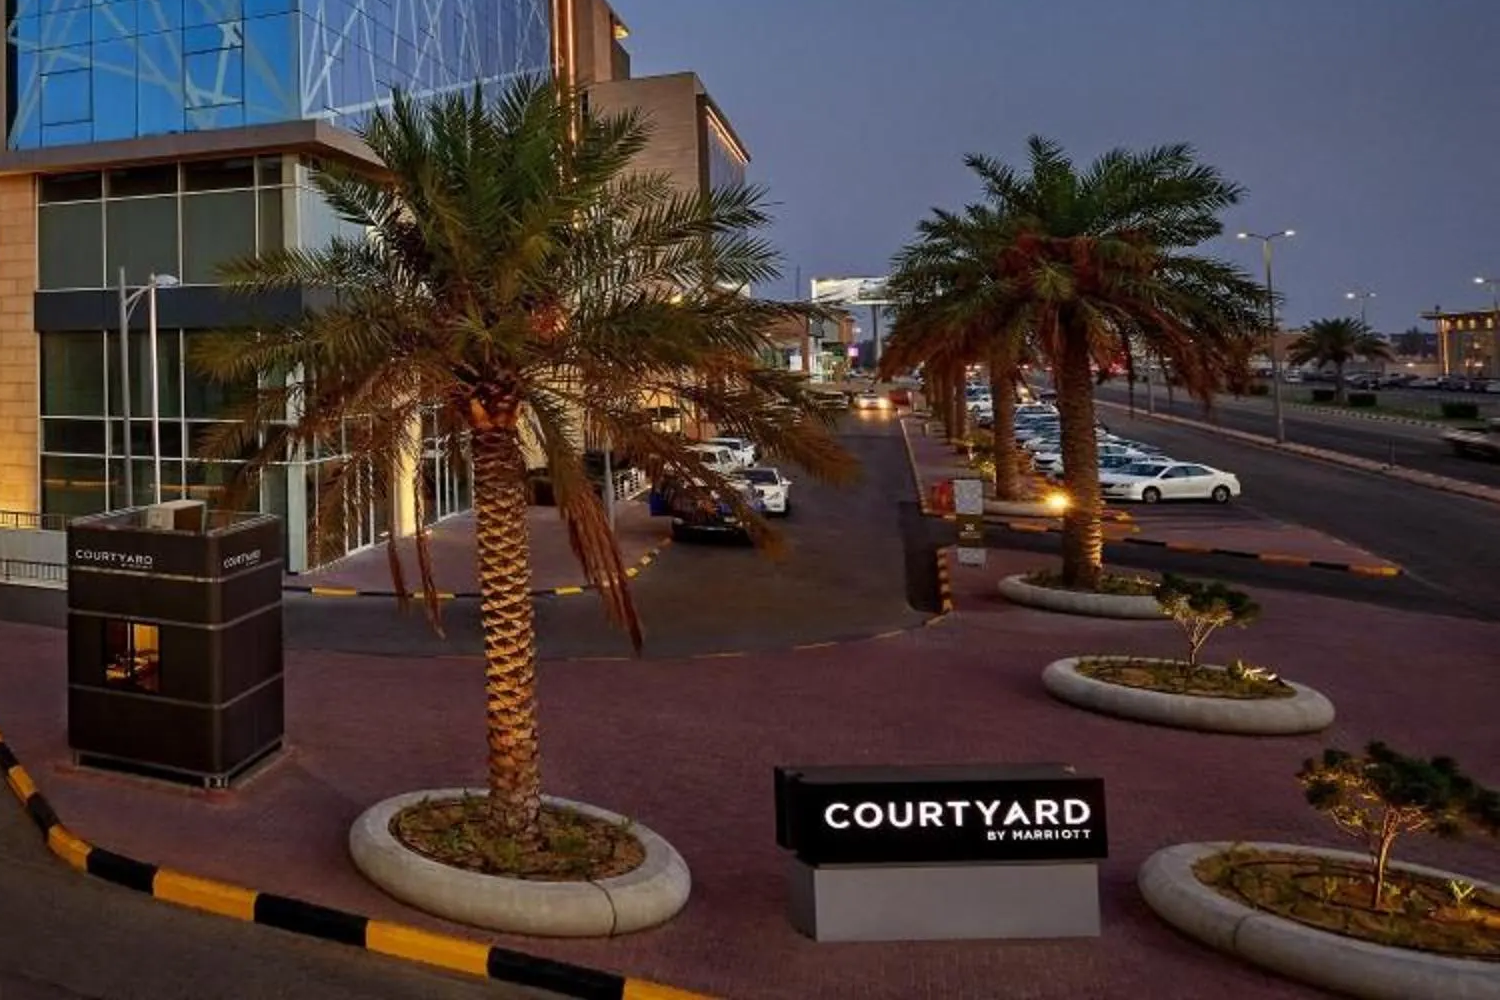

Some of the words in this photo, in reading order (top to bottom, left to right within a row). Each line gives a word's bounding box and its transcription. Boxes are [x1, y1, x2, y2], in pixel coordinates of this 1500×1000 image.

[75, 549, 153, 565] COURTYARD
[824, 799, 1091, 829] COURTYARD
[987, 831, 1006, 841] BY
[1012, 829, 1091, 840] MARRIOTT
